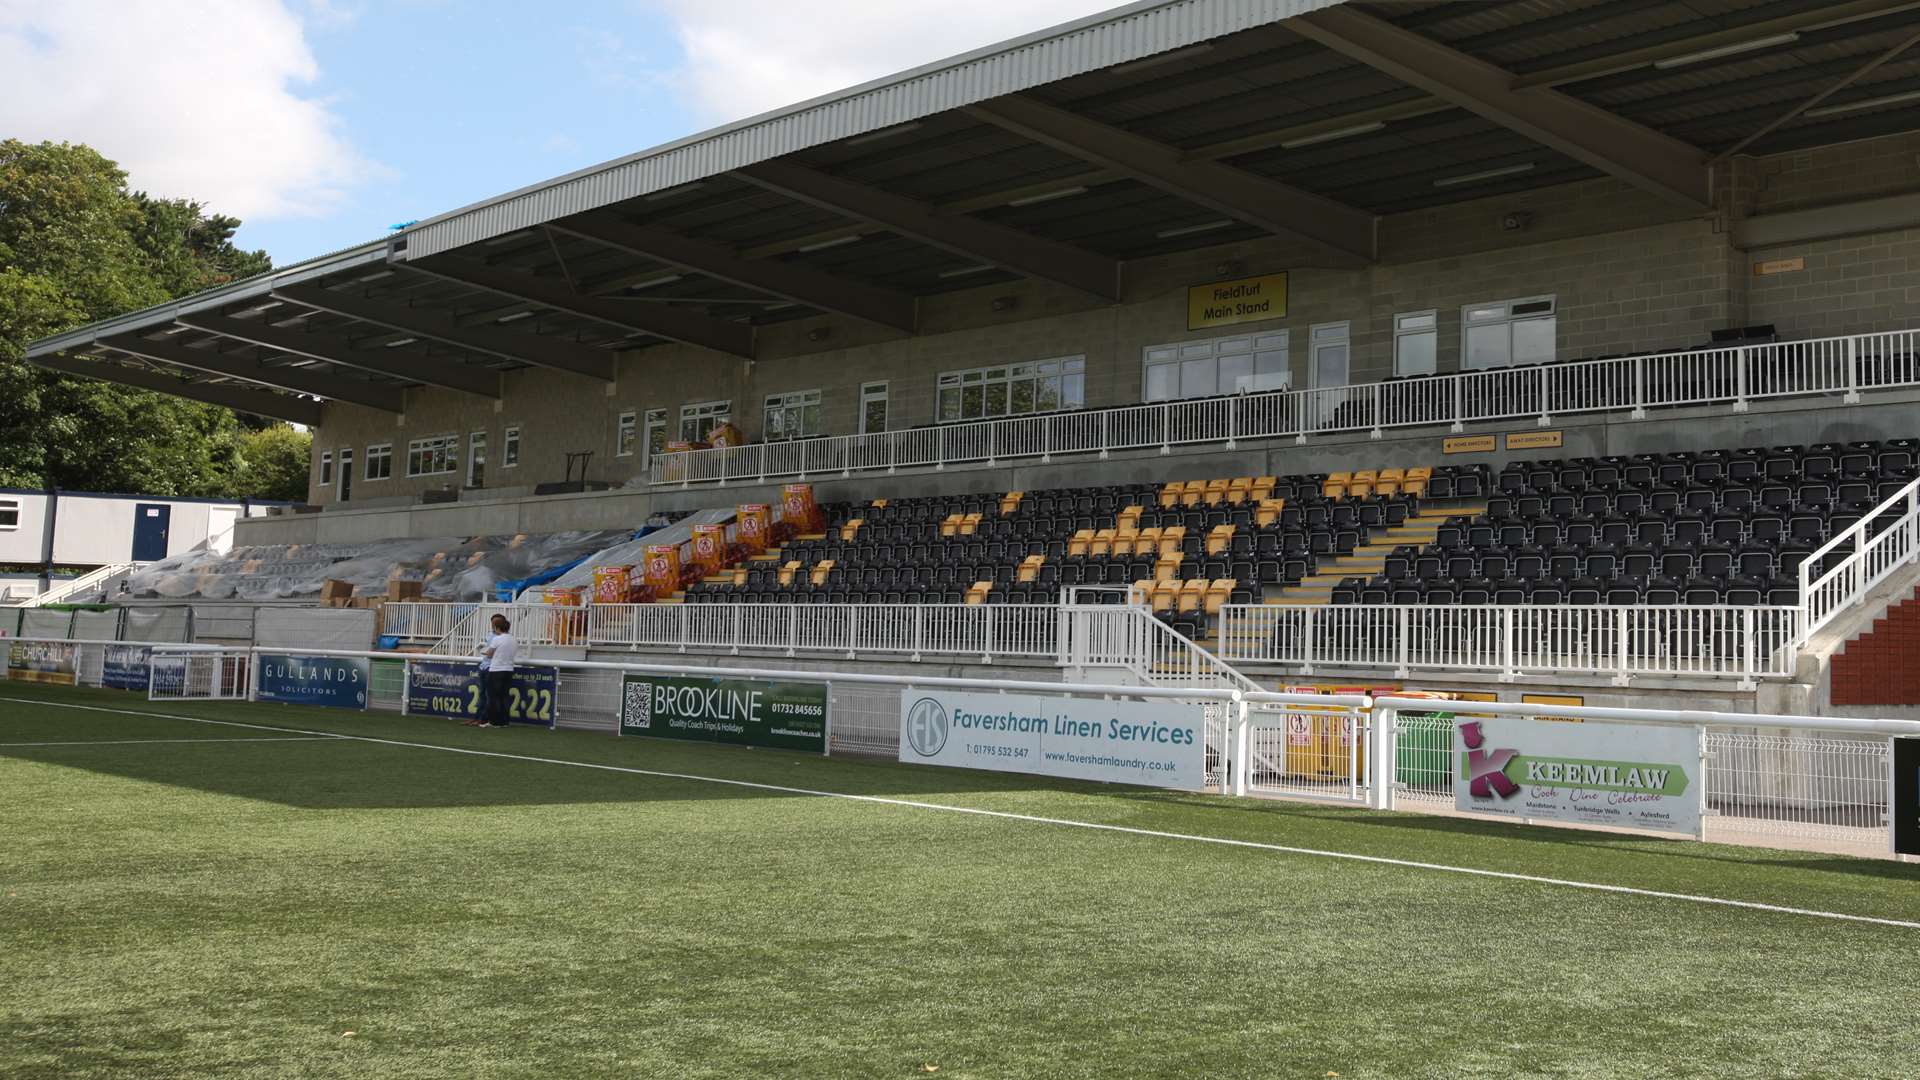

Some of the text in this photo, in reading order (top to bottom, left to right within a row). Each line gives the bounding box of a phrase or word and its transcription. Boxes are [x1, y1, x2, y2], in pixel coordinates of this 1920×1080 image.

[1214, 282, 1261, 300] FieldTurf
[1204, 300, 1270, 320] Main Stand
[22, 646, 63, 663] CHURCHILL
[265, 664, 359, 683] GULLANDS
[281, 685, 337, 695] SOLICITORS
[432, 696, 463, 713] 01622
[655, 685, 763, 722] BROOKLINE
[771, 703, 823, 716] 01732 845656
[669, 718, 687, 729] Quality
[687, 719, 704, 729] Coach
[704, 721, 716, 731] Trips
[721, 722, 744, 735] Holidays
[953, 708, 1194, 745] Faversham Linen Services
[973, 744, 996, 756] 01795
[997, 746, 1012, 757] 532
[1014, 747, 1029, 758] 547
[1045, 752, 1177, 773] www.favershamlaundry.co.uk
[1526, 761, 1669, 790] KEEMLAW
[1530, 784, 1559, 799] Cook
[1569, 786, 1600, 802] Dine
[1526, 801, 1557, 810] Maidstone
[1574, 805, 1604, 815] Tunbridge
[1640, 811, 1670, 819] Aylesford
